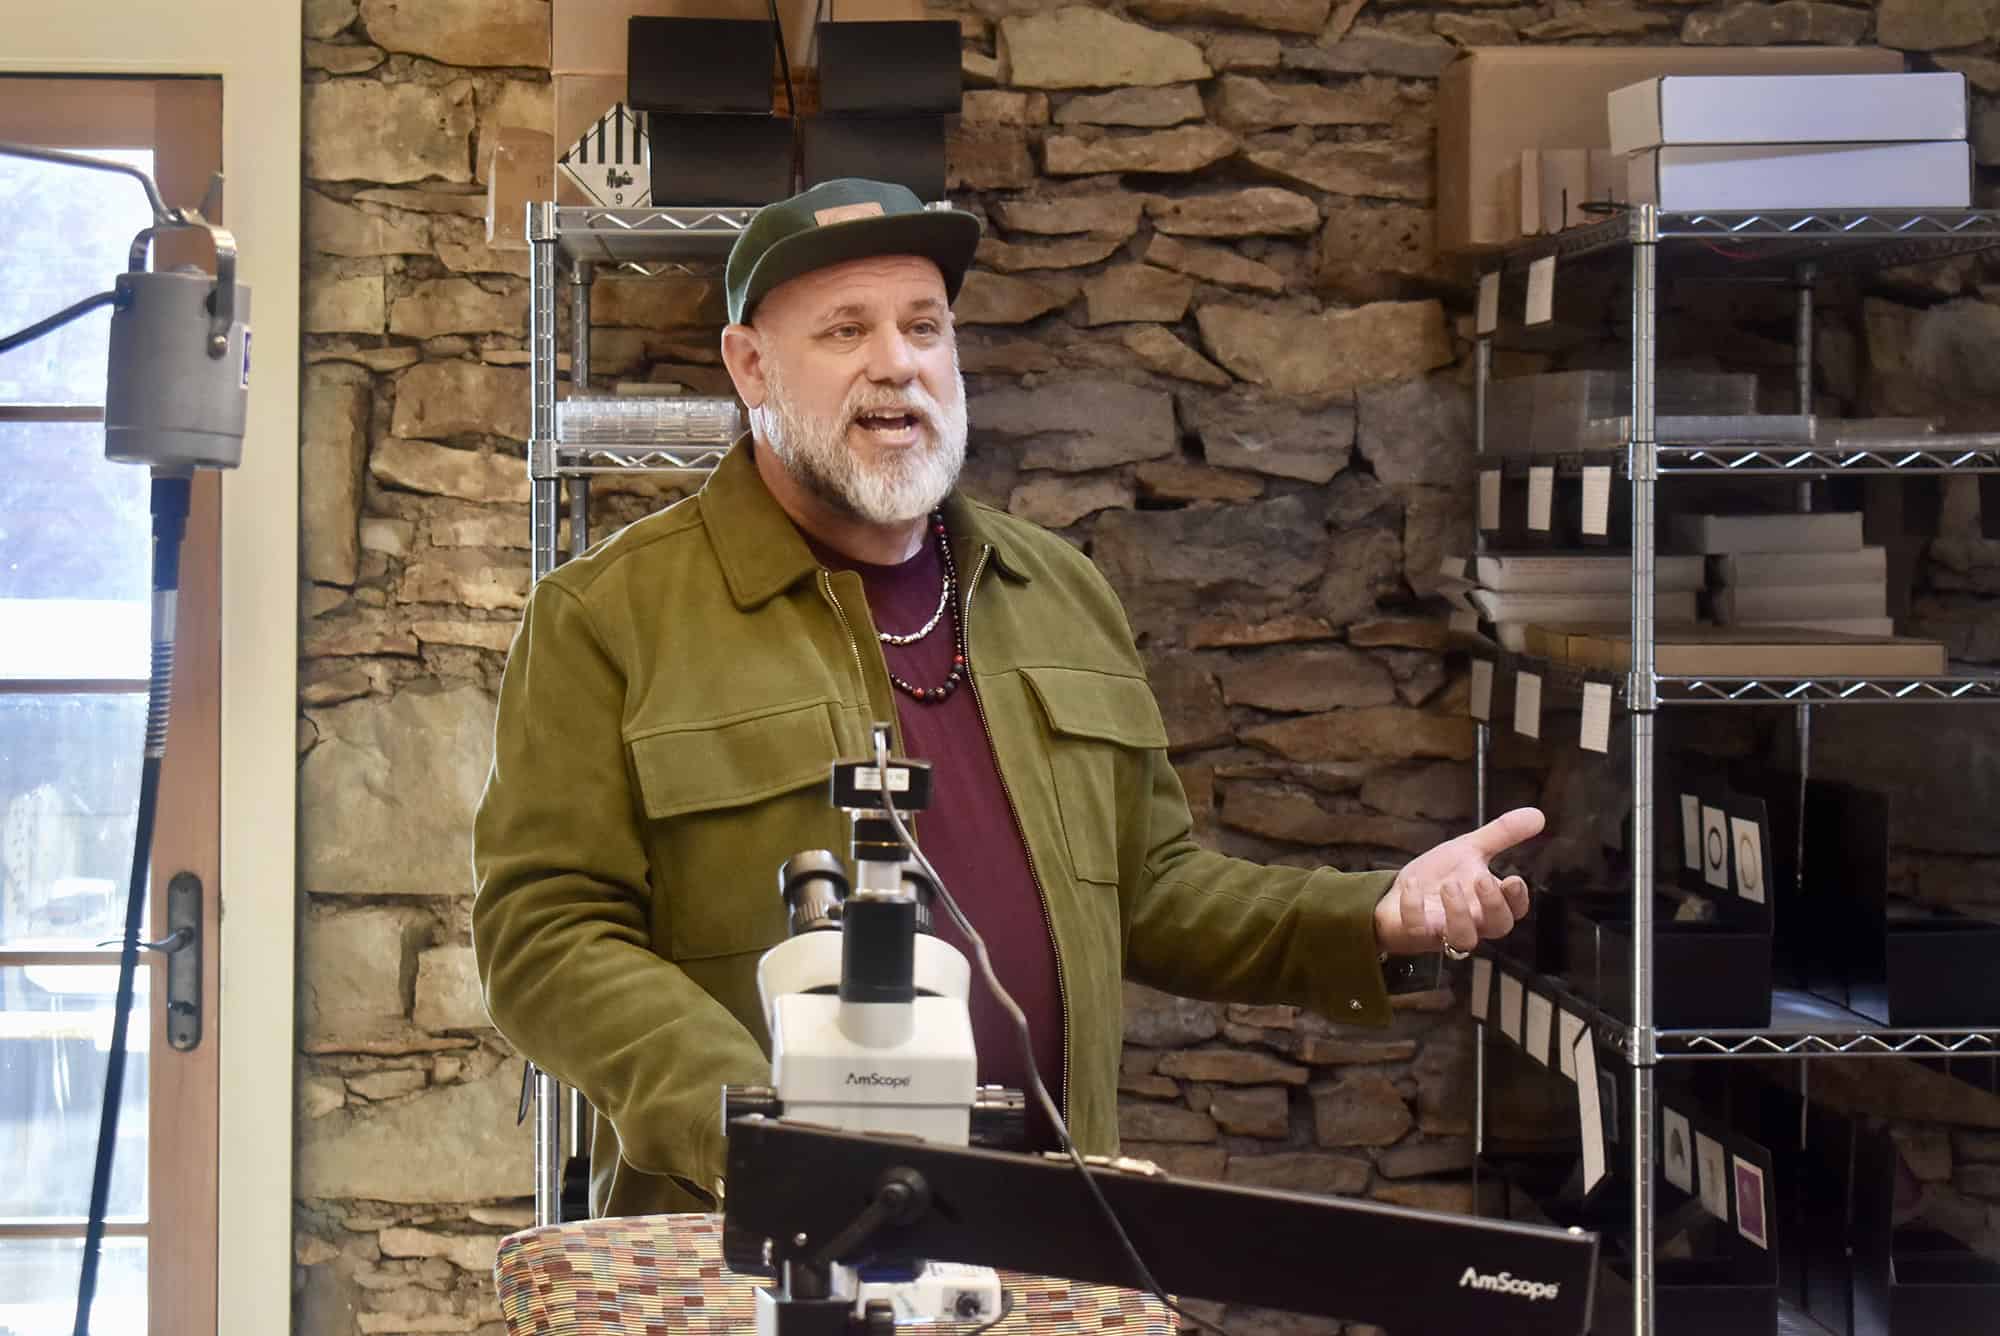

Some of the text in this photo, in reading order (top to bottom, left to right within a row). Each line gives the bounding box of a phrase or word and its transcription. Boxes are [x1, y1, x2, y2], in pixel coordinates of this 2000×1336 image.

[615, 193, 623, 205] 9
[846, 1072, 911, 1088] AmScope
[1459, 1266, 1559, 1300] AmScope
